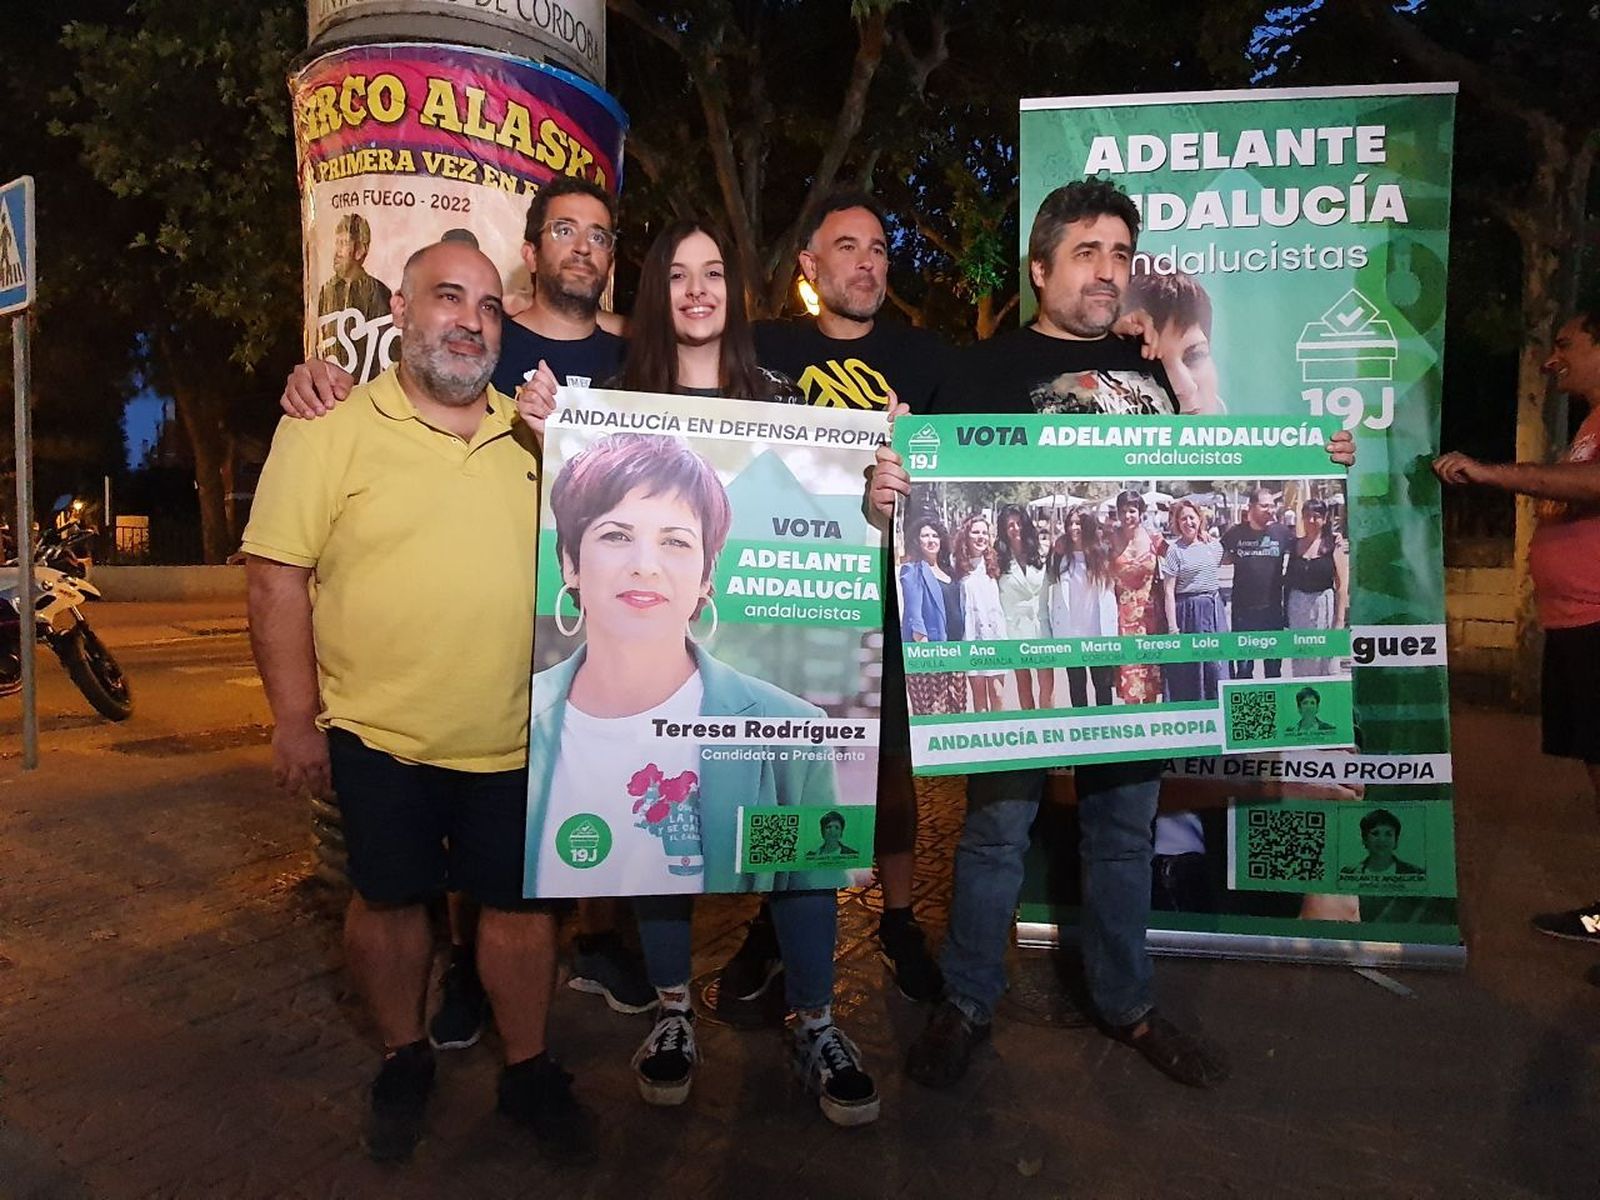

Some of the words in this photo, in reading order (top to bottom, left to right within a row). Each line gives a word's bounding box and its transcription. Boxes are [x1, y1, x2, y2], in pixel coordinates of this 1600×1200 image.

[420, 78, 607, 191] ALASKA
[1083, 125, 1387, 175] ADELANTE
[319, 148, 416, 181] PRIMERA
[422, 151, 478, 183] VEZ
[483, 165, 518, 195] EN
[331, 191, 360, 209] GIRA
[362, 189, 416, 207] FUEGO
[430, 194, 471, 213] 2022
[1131, 173, 1409, 232] DALUCÍA
[1131, 240, 1369, 276] ndalucistas
[1300, 386, 1395, 431] 19J
[559, 407, 681, 432] ANDALUCÍA
[687, 416, 713, 434] EN
[719, 419, 809, 441] DEFENSA
[814, 426, 887, 447] PROPIA
[957, 426, 1029, 446] VOTA
[1038, 426, 1172, 447] ADELANTE
[1179, 422, 1325, 447] ANDALUCÍA
[908, 454, 938, 470] 19J
[1124, 449, 1243, 465] andalucistas
[772, 517, 842, 540] VOTA
[738, 548, 872, 574] ADELANTE
[726, 576, 880, 601] ANDALUCÍA
[744, 601, 862, 622] andalucistas
[907, 644, 962, 659] Maribel
[969, 644, 996, 657] Ana
[1019, 642, 1072, 655] Carmen
[1081, 640, 1122, 653] Marta
[1135, 638, 1181, 650] Teresa
[1192, 636, 1219, 648] Lola
[1238, 635, 1278, 649] Diego
[1293, 633, 1327, 645] Inma
[652, 718, 736, 738] Teresa
[744, 720, 866, 745] Rodríguez
[927, 726, 1038, 752] ANDALUCÍA
[1043, 728, 1065, 744] EN
[1069, 721, 1146, 742] DEFENSA
[1151, 719, 1217, 737] PROPIA
[701, 748, 776, 761] Candidata
[780, 751, 789, 761] a
[792, 749, 865, 762] Presidenta
[1185, 758, 1215, 775] EN
[1223, 759, 1337, 779] DEFENSA
[1343, 762, 1435, 780] PROPIA
[570, 848, 598, 862] 19J
